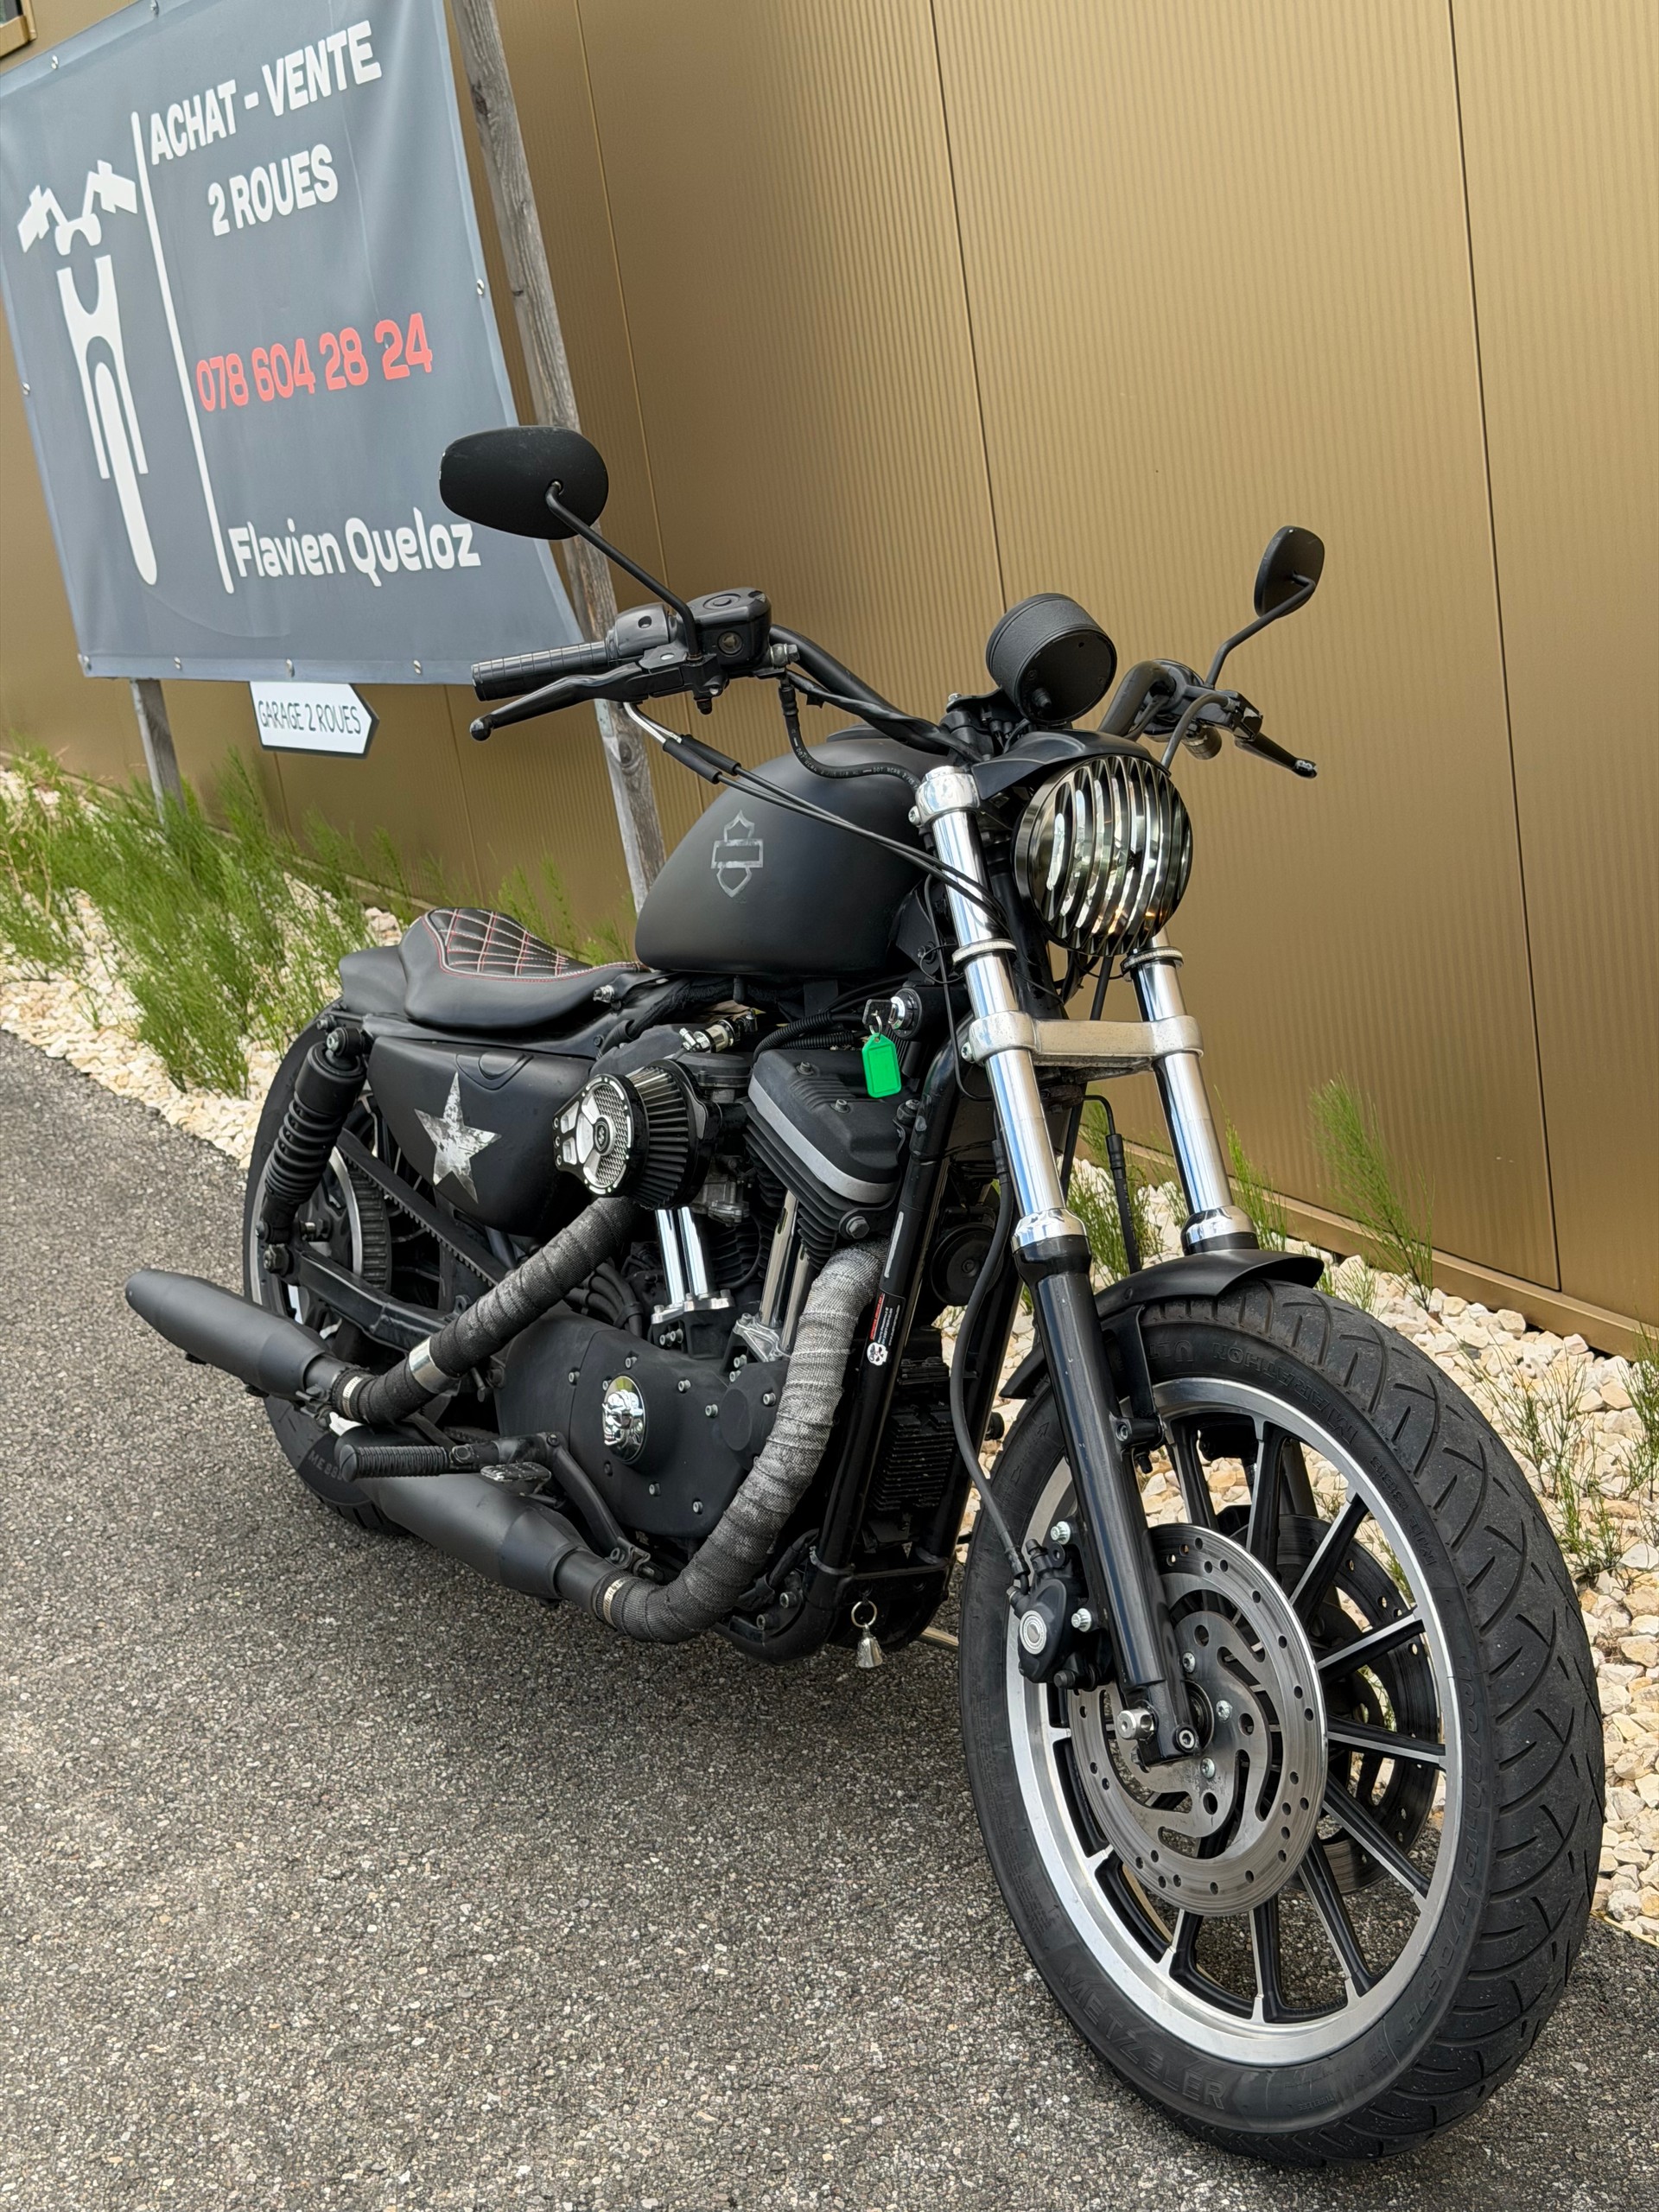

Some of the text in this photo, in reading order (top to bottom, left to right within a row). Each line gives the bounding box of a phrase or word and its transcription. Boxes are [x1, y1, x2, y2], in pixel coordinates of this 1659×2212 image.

[150, 20, 382, 166] ACHAT - VENTE
[207, 143, 339, 237] 2 ROUES
[196, 312, 433, 412] 078 604 28 24
[228, 506, 481, 587] Flavien Queloz
[258, 700, 361, 734] GARAGE 2 ROUES
[1147, 1338, 1195, 1363] ULT
[1211, 1341, 1360, 1446] MARATHON
[308, 1450, 326, 1471] ME
[1059, 1961, 1224, 2111] METZELER
